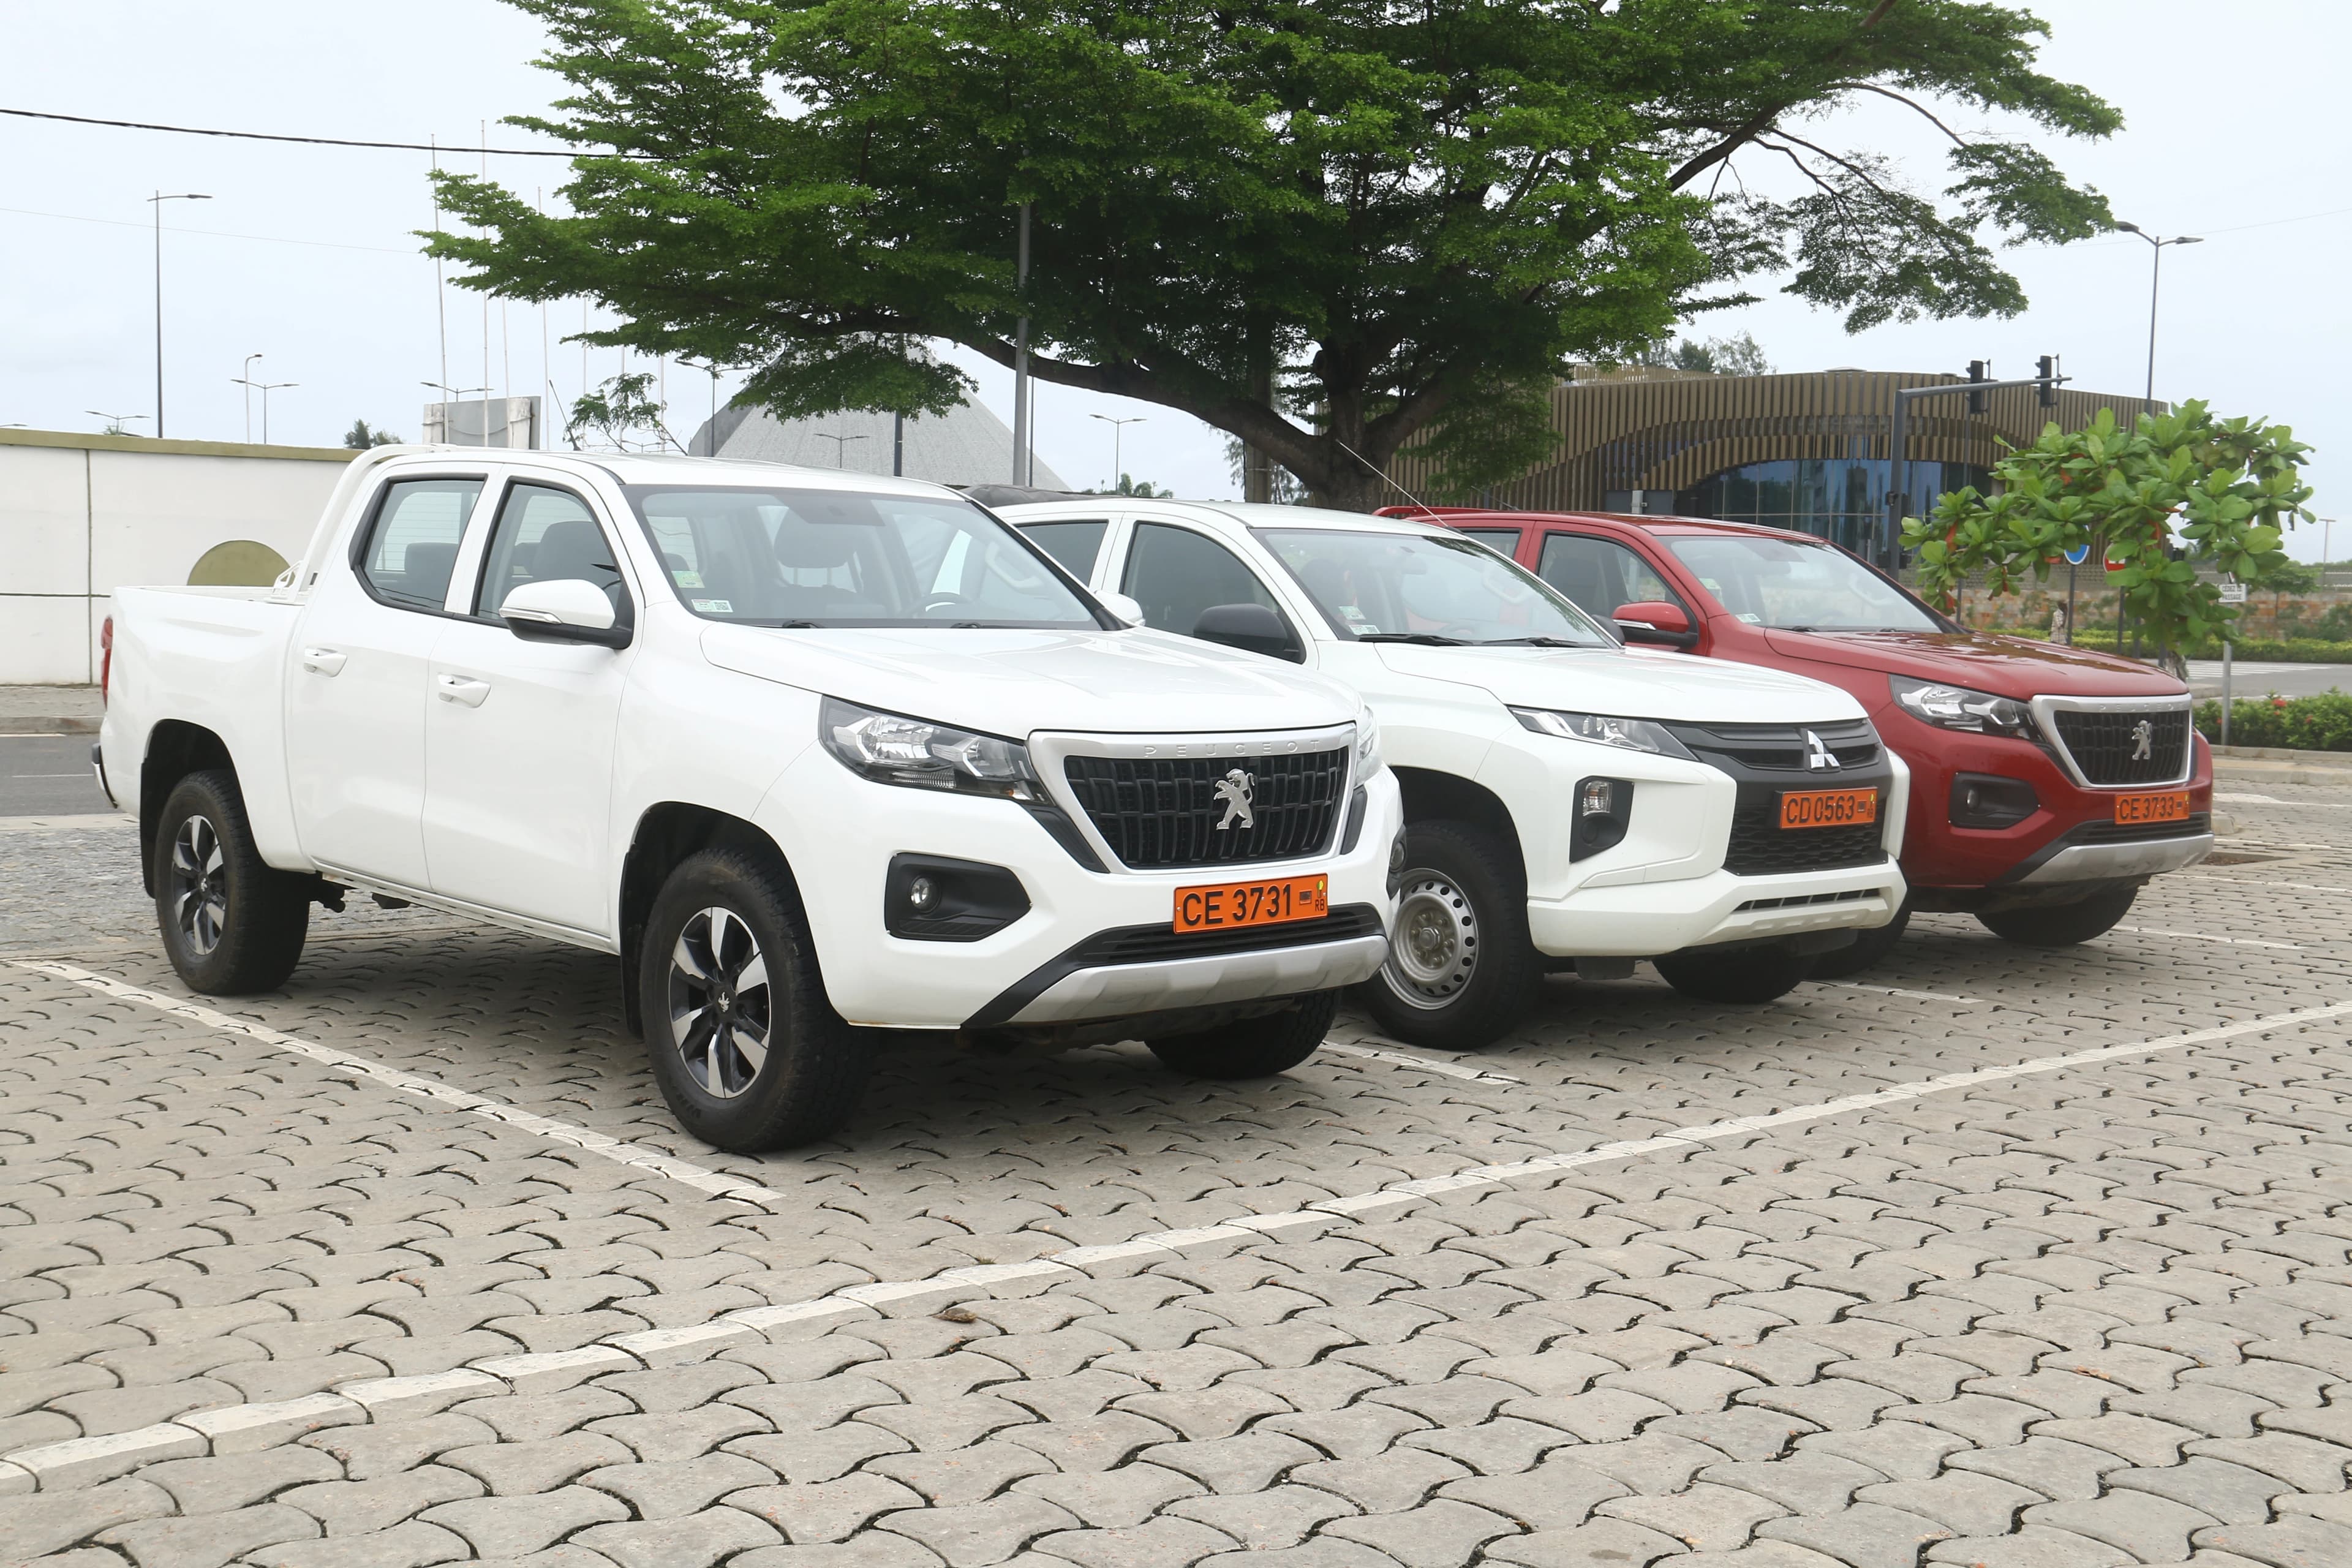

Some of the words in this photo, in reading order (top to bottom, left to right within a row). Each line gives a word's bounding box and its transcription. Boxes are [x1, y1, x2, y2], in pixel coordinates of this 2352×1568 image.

[2099, 703, 2185, 712] PEGEO
[1144, 740, 1320, 758] PEUGEOT
[1787, 797, 1811, 823] CD
[1814, 795, 1855, 822] 0563
[2120, 798, 2140, 820] CE
[2143, 796, 2174, 818] 3733
[1182, 891, 1224, 925] CE
[1232, 884, 1291, 921] 3731
[1315, 899, 1324, 911] RB
